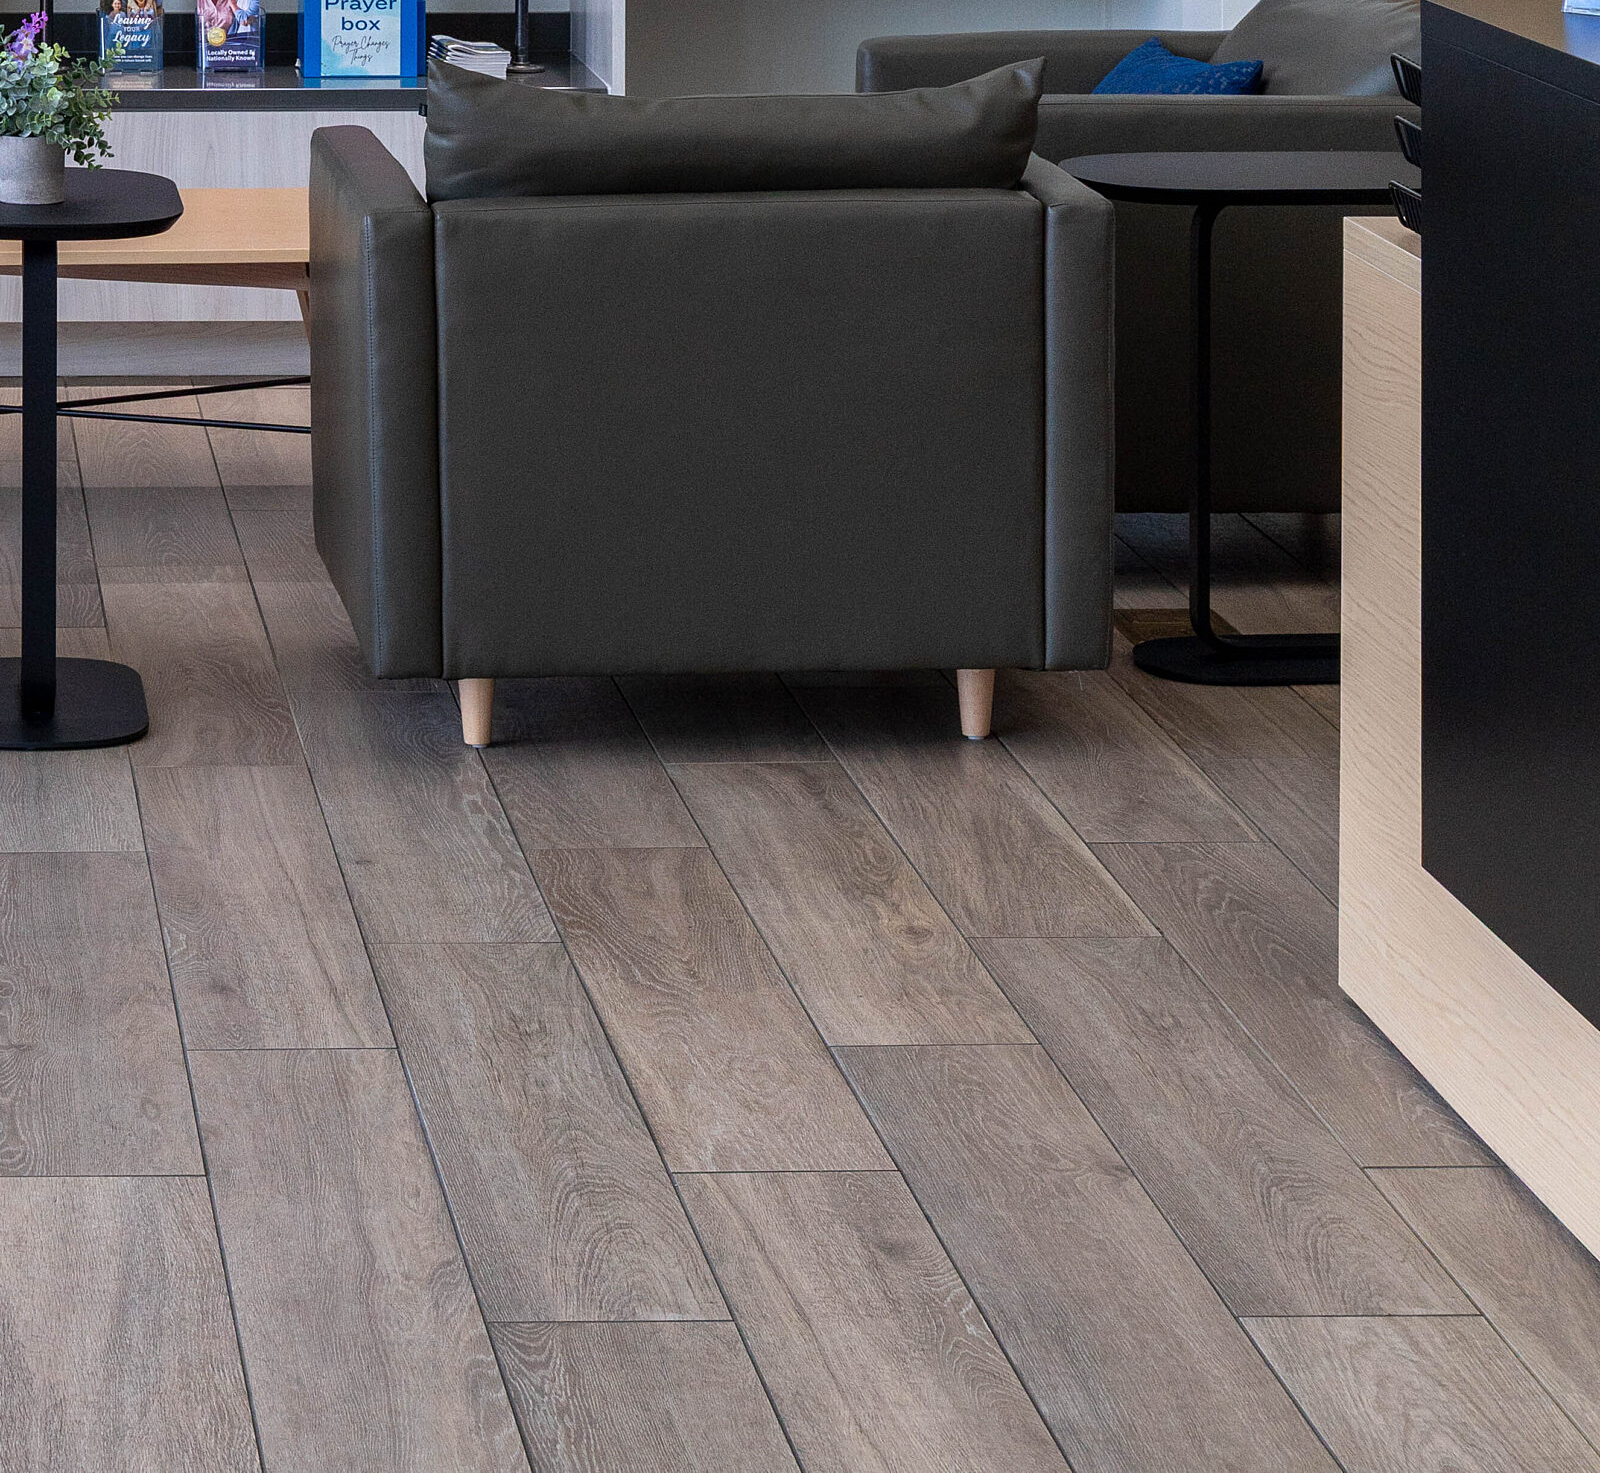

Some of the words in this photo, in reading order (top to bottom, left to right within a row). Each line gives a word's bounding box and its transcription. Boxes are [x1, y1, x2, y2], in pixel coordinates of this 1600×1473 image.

[111, 14, 153, 29] Leaving
[341, 16, 381, 31] box
[113, 31, 151, 47] Legacy
[332, 35, 360, 51] Prayer
[360, 36, 390, 53] Changes
[346, 47, 373, 66] Things
